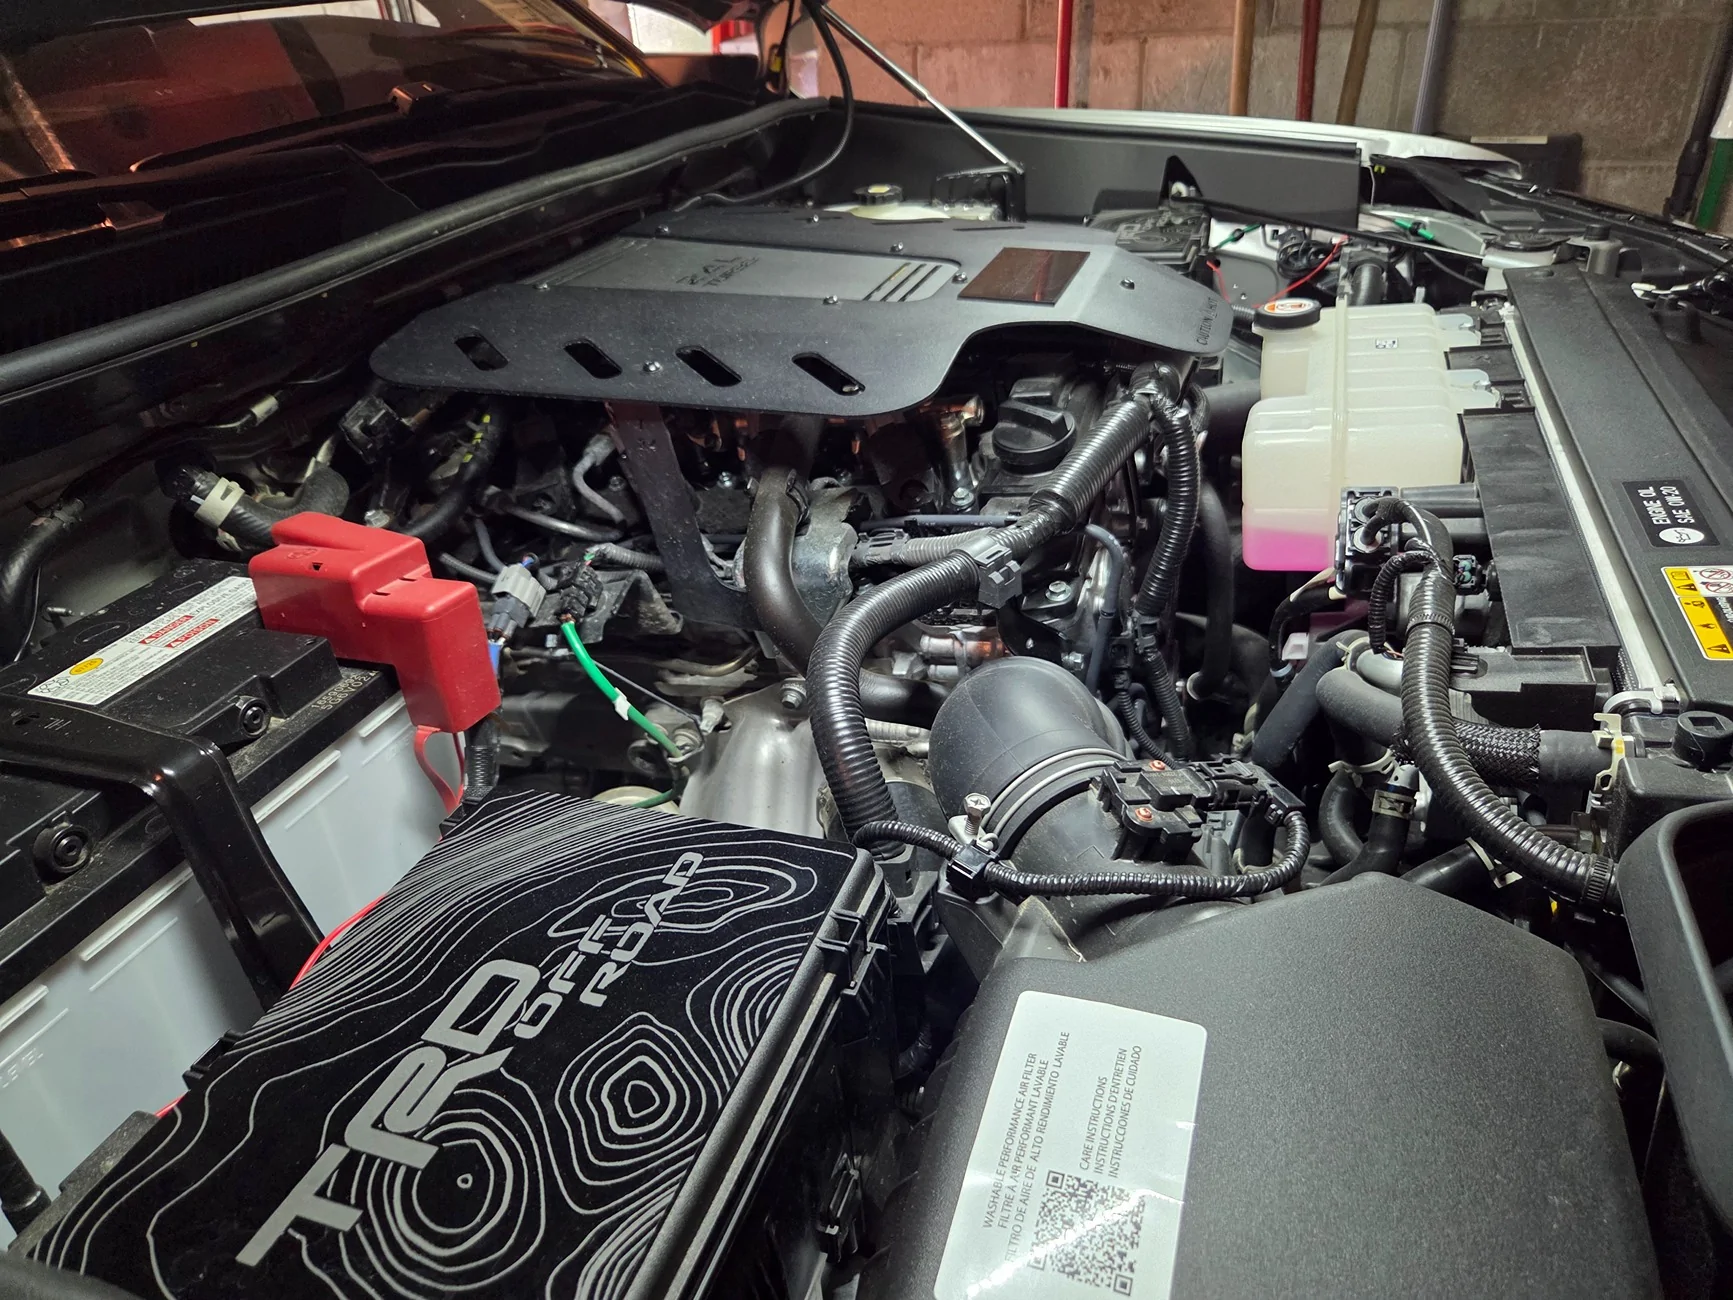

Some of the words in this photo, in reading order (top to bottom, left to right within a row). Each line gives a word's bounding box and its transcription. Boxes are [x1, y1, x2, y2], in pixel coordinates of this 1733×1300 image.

[1196, 318, 1213, 345] CAUTION
[1637, 486, 1656, 497] OIL
[1660, 486, 1685, 506] 0W-20
[1643, 500, 1671, 524] ENGINE
[1672, 509, 1695, 523] SAE
[179, 619, 217, 640] POISON
[579, 852, 703, 1007] ROAD
[1053, 1031, 1070, 1068] LAVABLE
[1022, 1053, 1037, 1081] FILTER
[1031, 1059, 1049, 1098] LAVABLE
[1125, 1045, 1143, 1086] CUIDADO
[235, 959, 541, 1266] TRD
[514, 914, 612, 1039] OFF
[1018, 1081, 1029, 1097] AIR
[1037, 1070, 1060, 1134] RENDIMIENTO
[1123, 1087, 1135, 1101] DE
[1085, 1076, 1108, 1143] INSTRUCTIONS
[1094, 1104, 1116, 1174] INSTRUCTIONS
[1107, 1048, 1128, 1103] D'ENTRETIEN
[1000, 1097, 1025, 1167] PERFORMANCE
[1014, 1099, 1038, 1161] PERFORMANT
[1108, 1101, 1131, 1178] INSTRUCCIONES
[1029, 1134, 1044, 1162] ALTO
[1080, 1144, 1094, 1171] CARE
[1011, 1163, 1021, 1183] AIR
[1025, 1165, 1037, 1180] DE
[983, 1168, 1005, 1228] WASHABLE
[1020, 1180, 1032, 1206] AIRE
[998, 1193, 1015, 1229] FILTRE
[1015, 1207, 1025, 1223] DE
[1004, 1224, 1022, 1262] FILTRO
